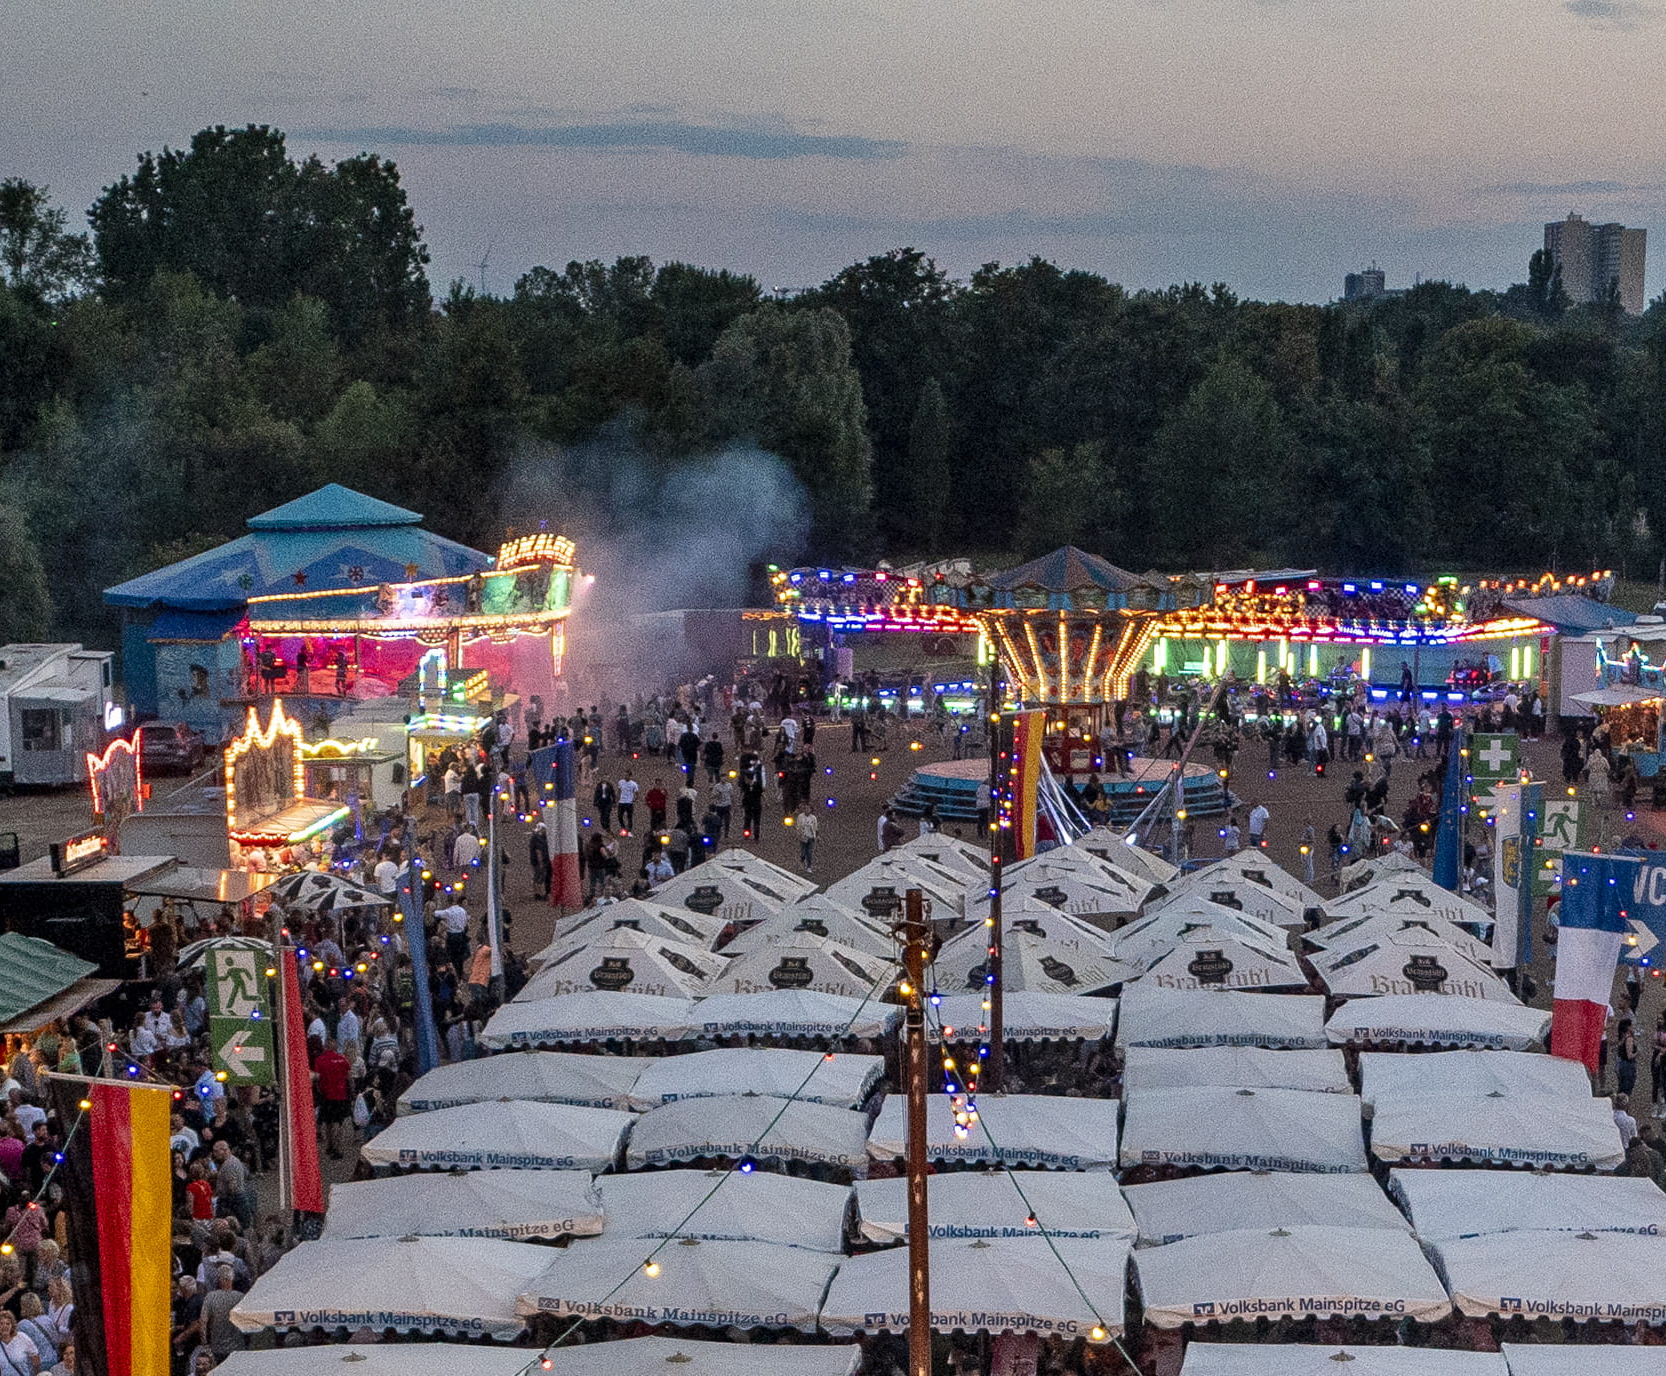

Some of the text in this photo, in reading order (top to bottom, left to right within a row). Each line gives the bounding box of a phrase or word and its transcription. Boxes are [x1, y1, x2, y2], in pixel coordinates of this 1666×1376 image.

[530, 1026, 658, 1040] Volksbank Mainspitze eG
[721, 1021, 849, 1034] Volksbank Mainspitze eG
[1003, 1026, 1060, 1038] Mainspitze
[1062, 1026, 1077, 1036] eG
[1372, 1027, 1503, 1044] Volksbank Mainspitze eG
[1148, 1034, 1305, 1048] Volksbank Mainspitze eG
[594, 1097, 614, 1109] eG
[420, 1150, 574, 1168] Volksbank Mainspitze eG
[667, 1142, 849, 1166] Volksbank Mainspitze eG
[926, 1145, 1079, 1166] Volksbank Mainspitze eG
[1432, 1143, 1588, 1164] Volksbank Mainspitze eG
[1164, 1151, 1349, 1174] Volksbank Mainspitze eG
[553, 1219, 574, 1231] eG
[928, 1224, 997, 1238] Volksbank
[1639, 1224, 1658, 1236] eG
[564, 1300, 787, 1327] Volksbank Mainspitze eG
[1219, 1297, 1405, 1314] Volksbank Mainspitze eG
[1526, 1299, 1603, 1316] Volksbank
[299, 1310, 482, 1330] Volksbank Mainspitze eG
[891, 1312, 1078, 1333] Vobank Mainspitze eG
